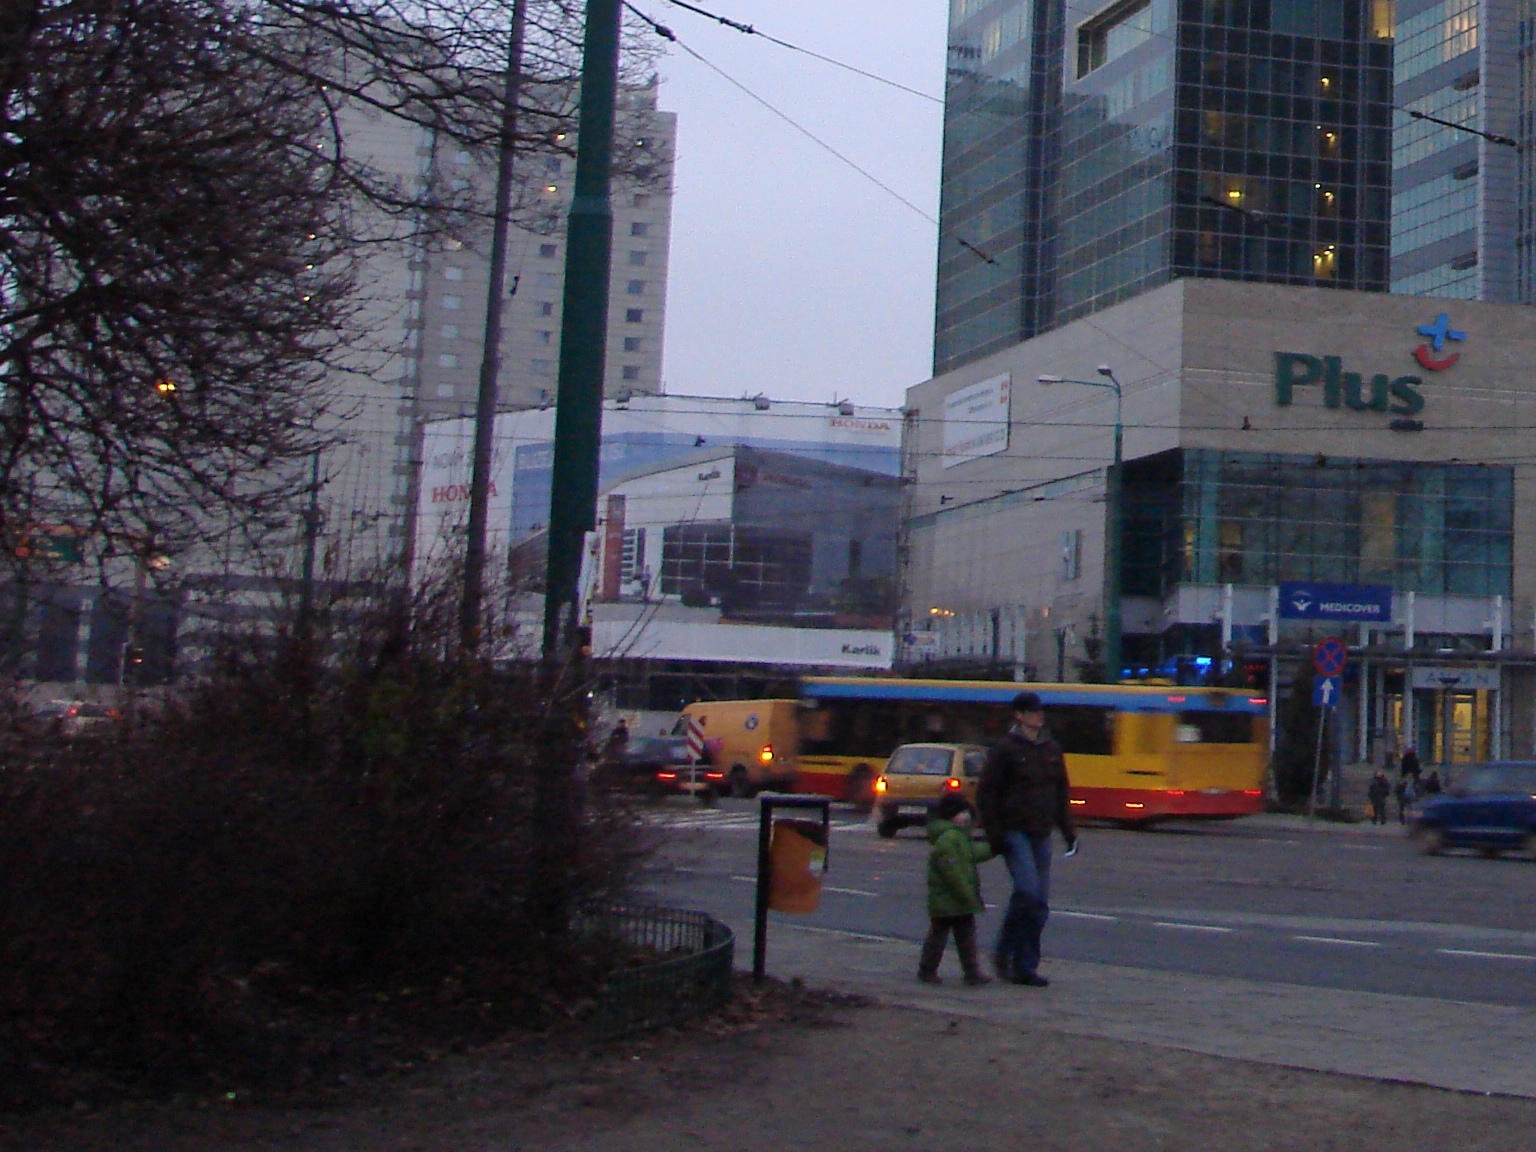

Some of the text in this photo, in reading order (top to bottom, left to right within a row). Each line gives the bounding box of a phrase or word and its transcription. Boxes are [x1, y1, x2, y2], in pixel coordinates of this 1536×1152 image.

[1274, 351, 1425, 415] Plus
[431, 481, 498, 503] HONA
[1319, 601, 1381, 615] MEDICOVER
[841, 644, 881, 656] Karlik
